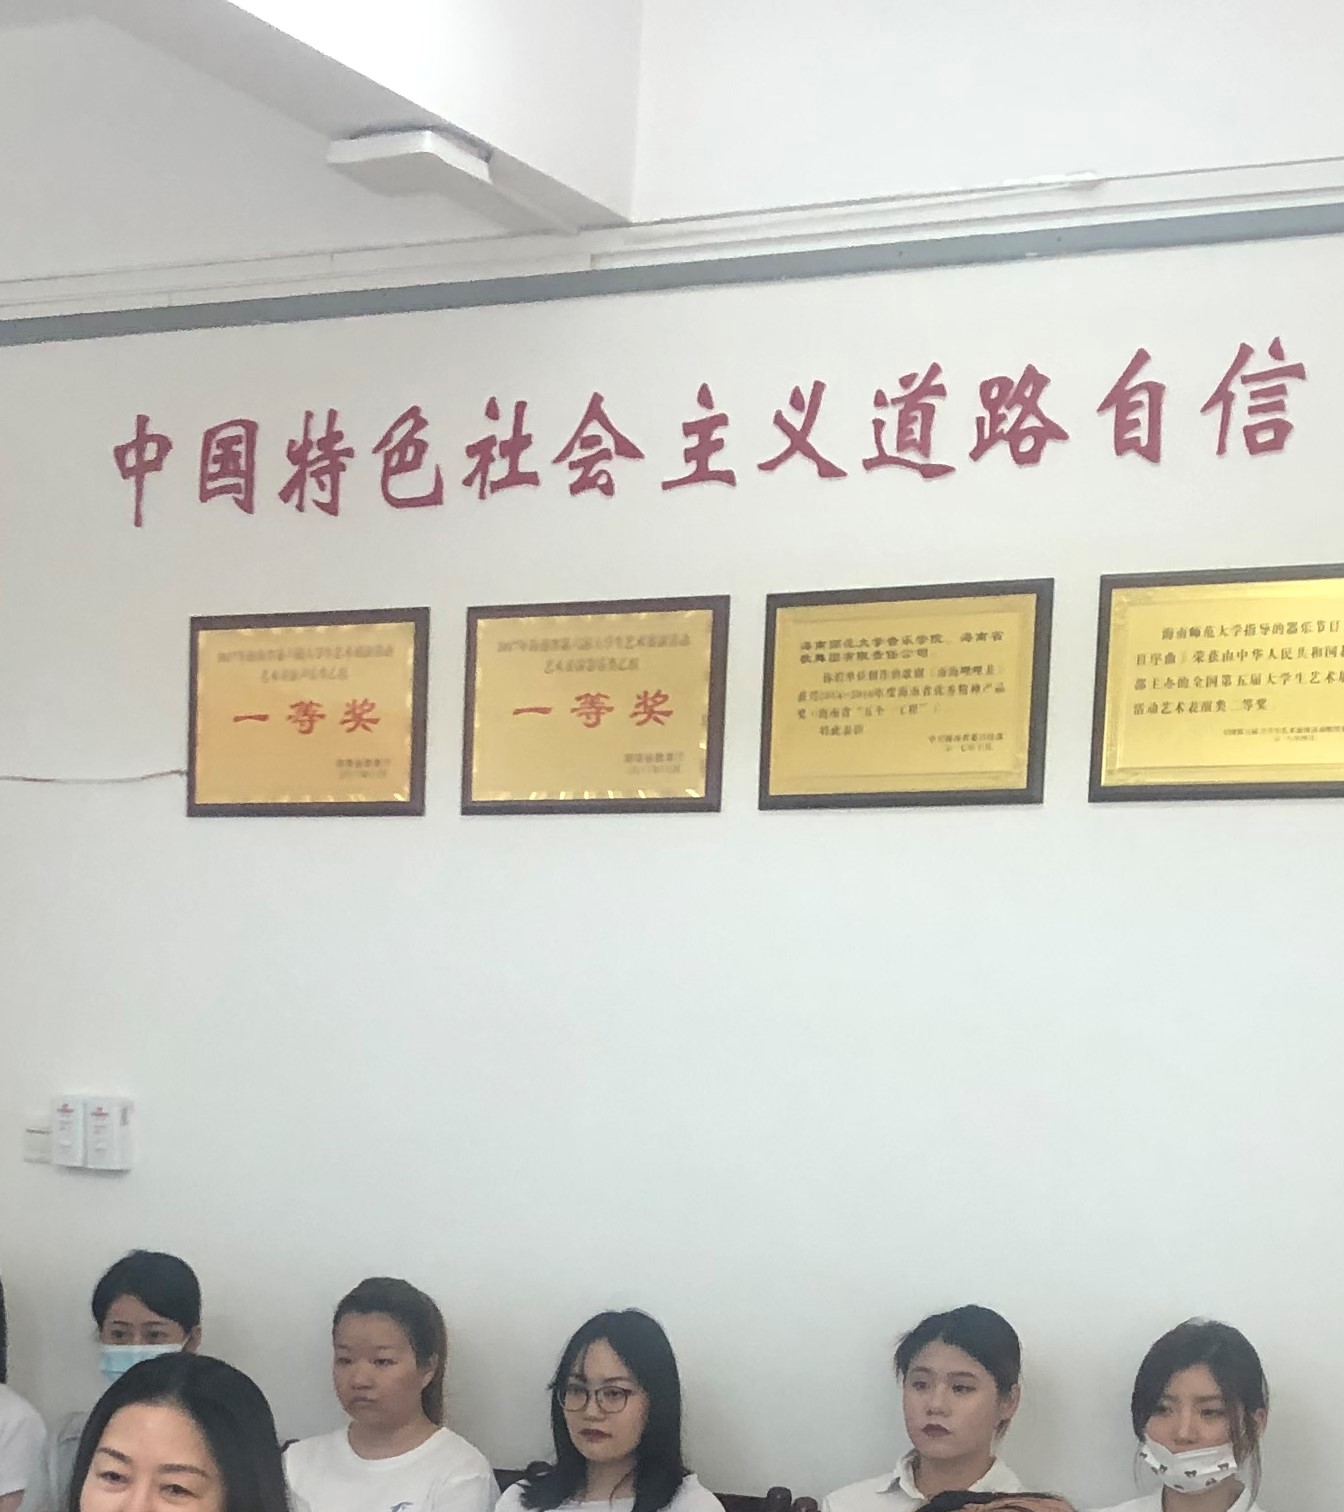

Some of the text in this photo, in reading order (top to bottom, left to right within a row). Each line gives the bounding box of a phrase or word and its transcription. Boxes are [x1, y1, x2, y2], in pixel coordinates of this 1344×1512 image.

[113, 336, 1307, 528] 中国特色社会主义道路自信
[233, 698, 381, 735] 一等奖
[513, 690, 674, 728] 一等奖
